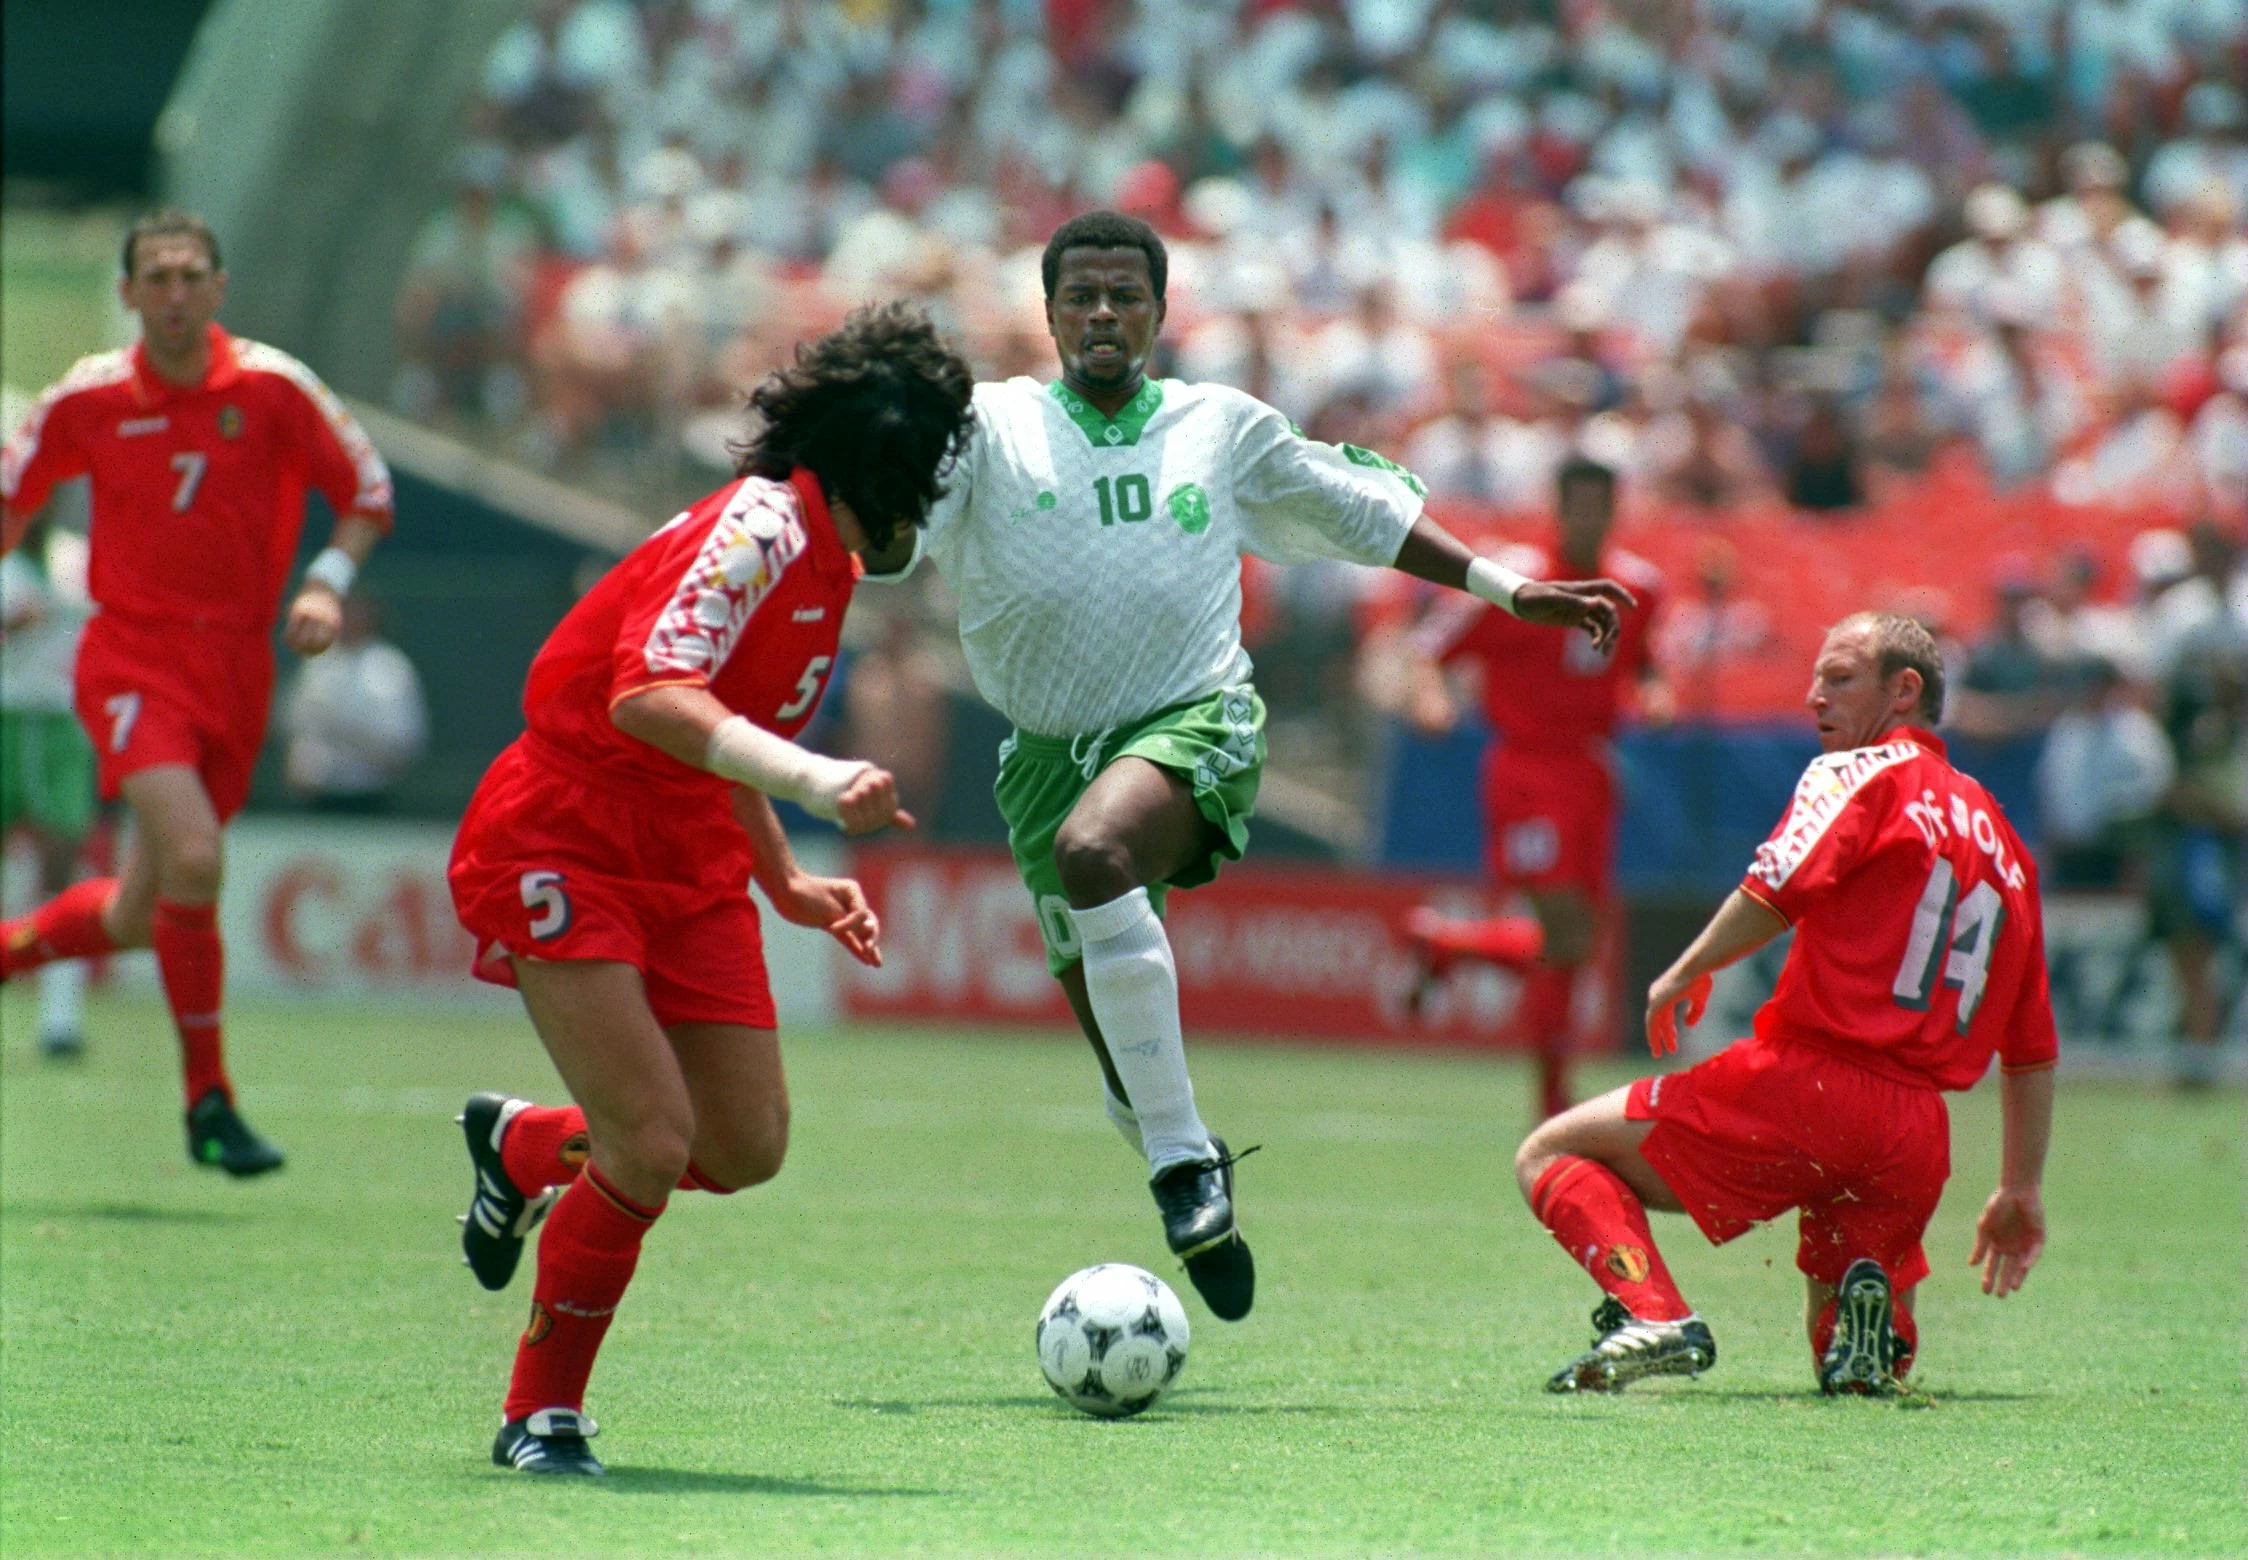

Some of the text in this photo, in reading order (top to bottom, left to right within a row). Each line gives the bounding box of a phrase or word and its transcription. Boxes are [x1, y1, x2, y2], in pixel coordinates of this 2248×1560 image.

[170, 451, 206, 511] 7
[1092, 473, 1152, 526] 10
[775, 655, 832, 720] 5
[105, 693, 141, 753] 7
[519, 870, 572, 941] 5
[1893, 853, 2006, 1037] 14
